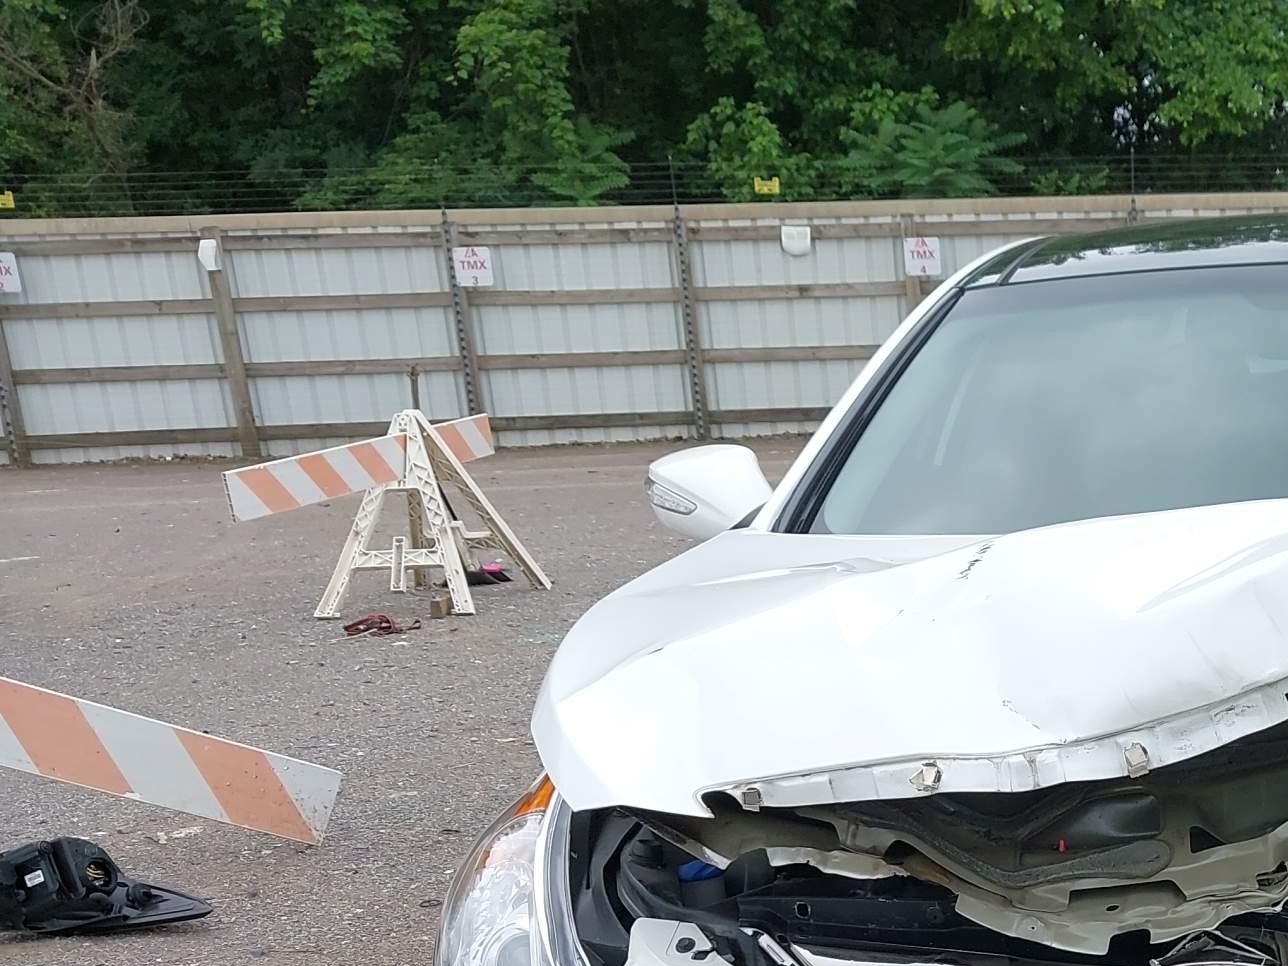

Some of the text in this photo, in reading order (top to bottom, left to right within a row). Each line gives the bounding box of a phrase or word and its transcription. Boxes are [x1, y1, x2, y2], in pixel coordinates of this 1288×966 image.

[910, 249, 936, 260] TMX
[458, 259, 487, 270] TMX
[471, 275, 479, 285] 3
